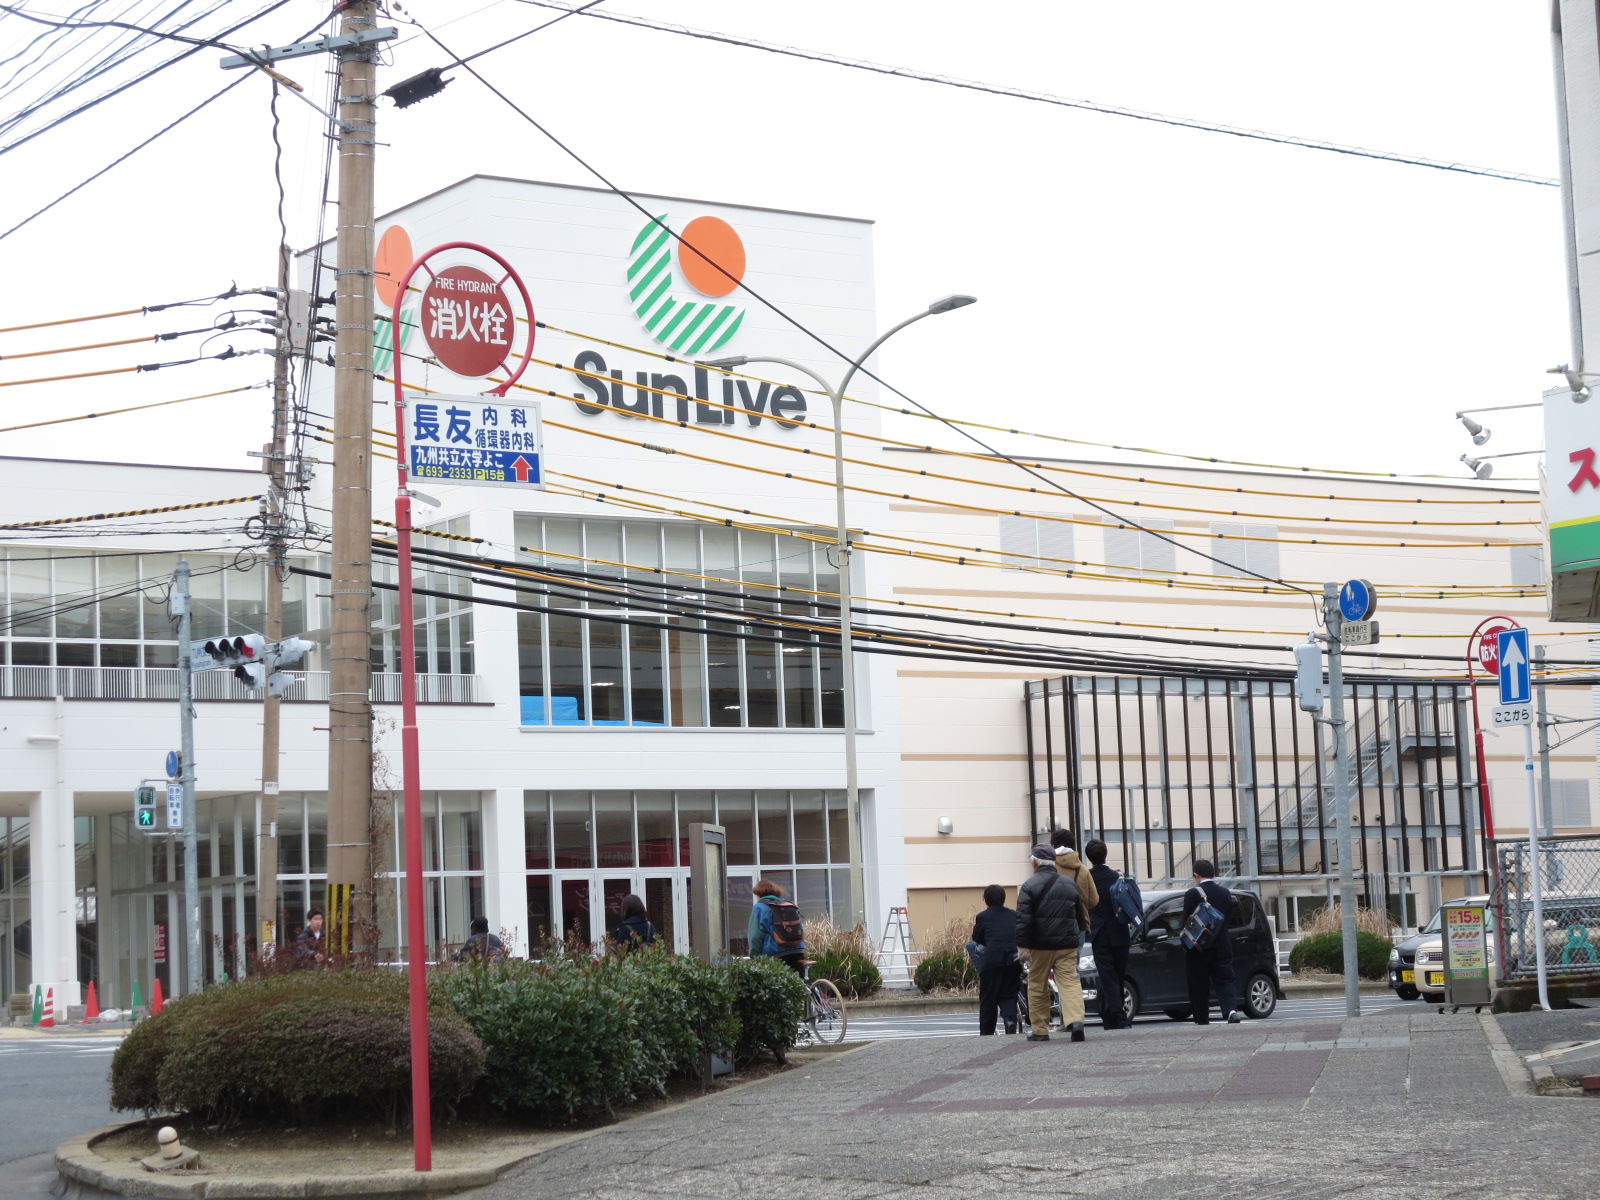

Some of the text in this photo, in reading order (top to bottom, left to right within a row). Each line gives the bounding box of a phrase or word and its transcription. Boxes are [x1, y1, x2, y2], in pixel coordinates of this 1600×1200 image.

[435, 276, 498, 295] FIRE HYDRANT
[428, 296, 508, 346] 消火栓
[573, 350, 808, 430] SunLive
[413, 403, 473, 445] 長友
[475, 428, 535, 452] 循環器内科
[415, 446, 505, 468] 九州共立大学よこ
[425, 465, 472, 479] 693-2333
[1345, 634, 1368, 643] ここから
[1483, 633, 1492, 641] FIRE
[1480, 643, 1499, 663] 防火
[1495, 709, 1530, 723] ここから
